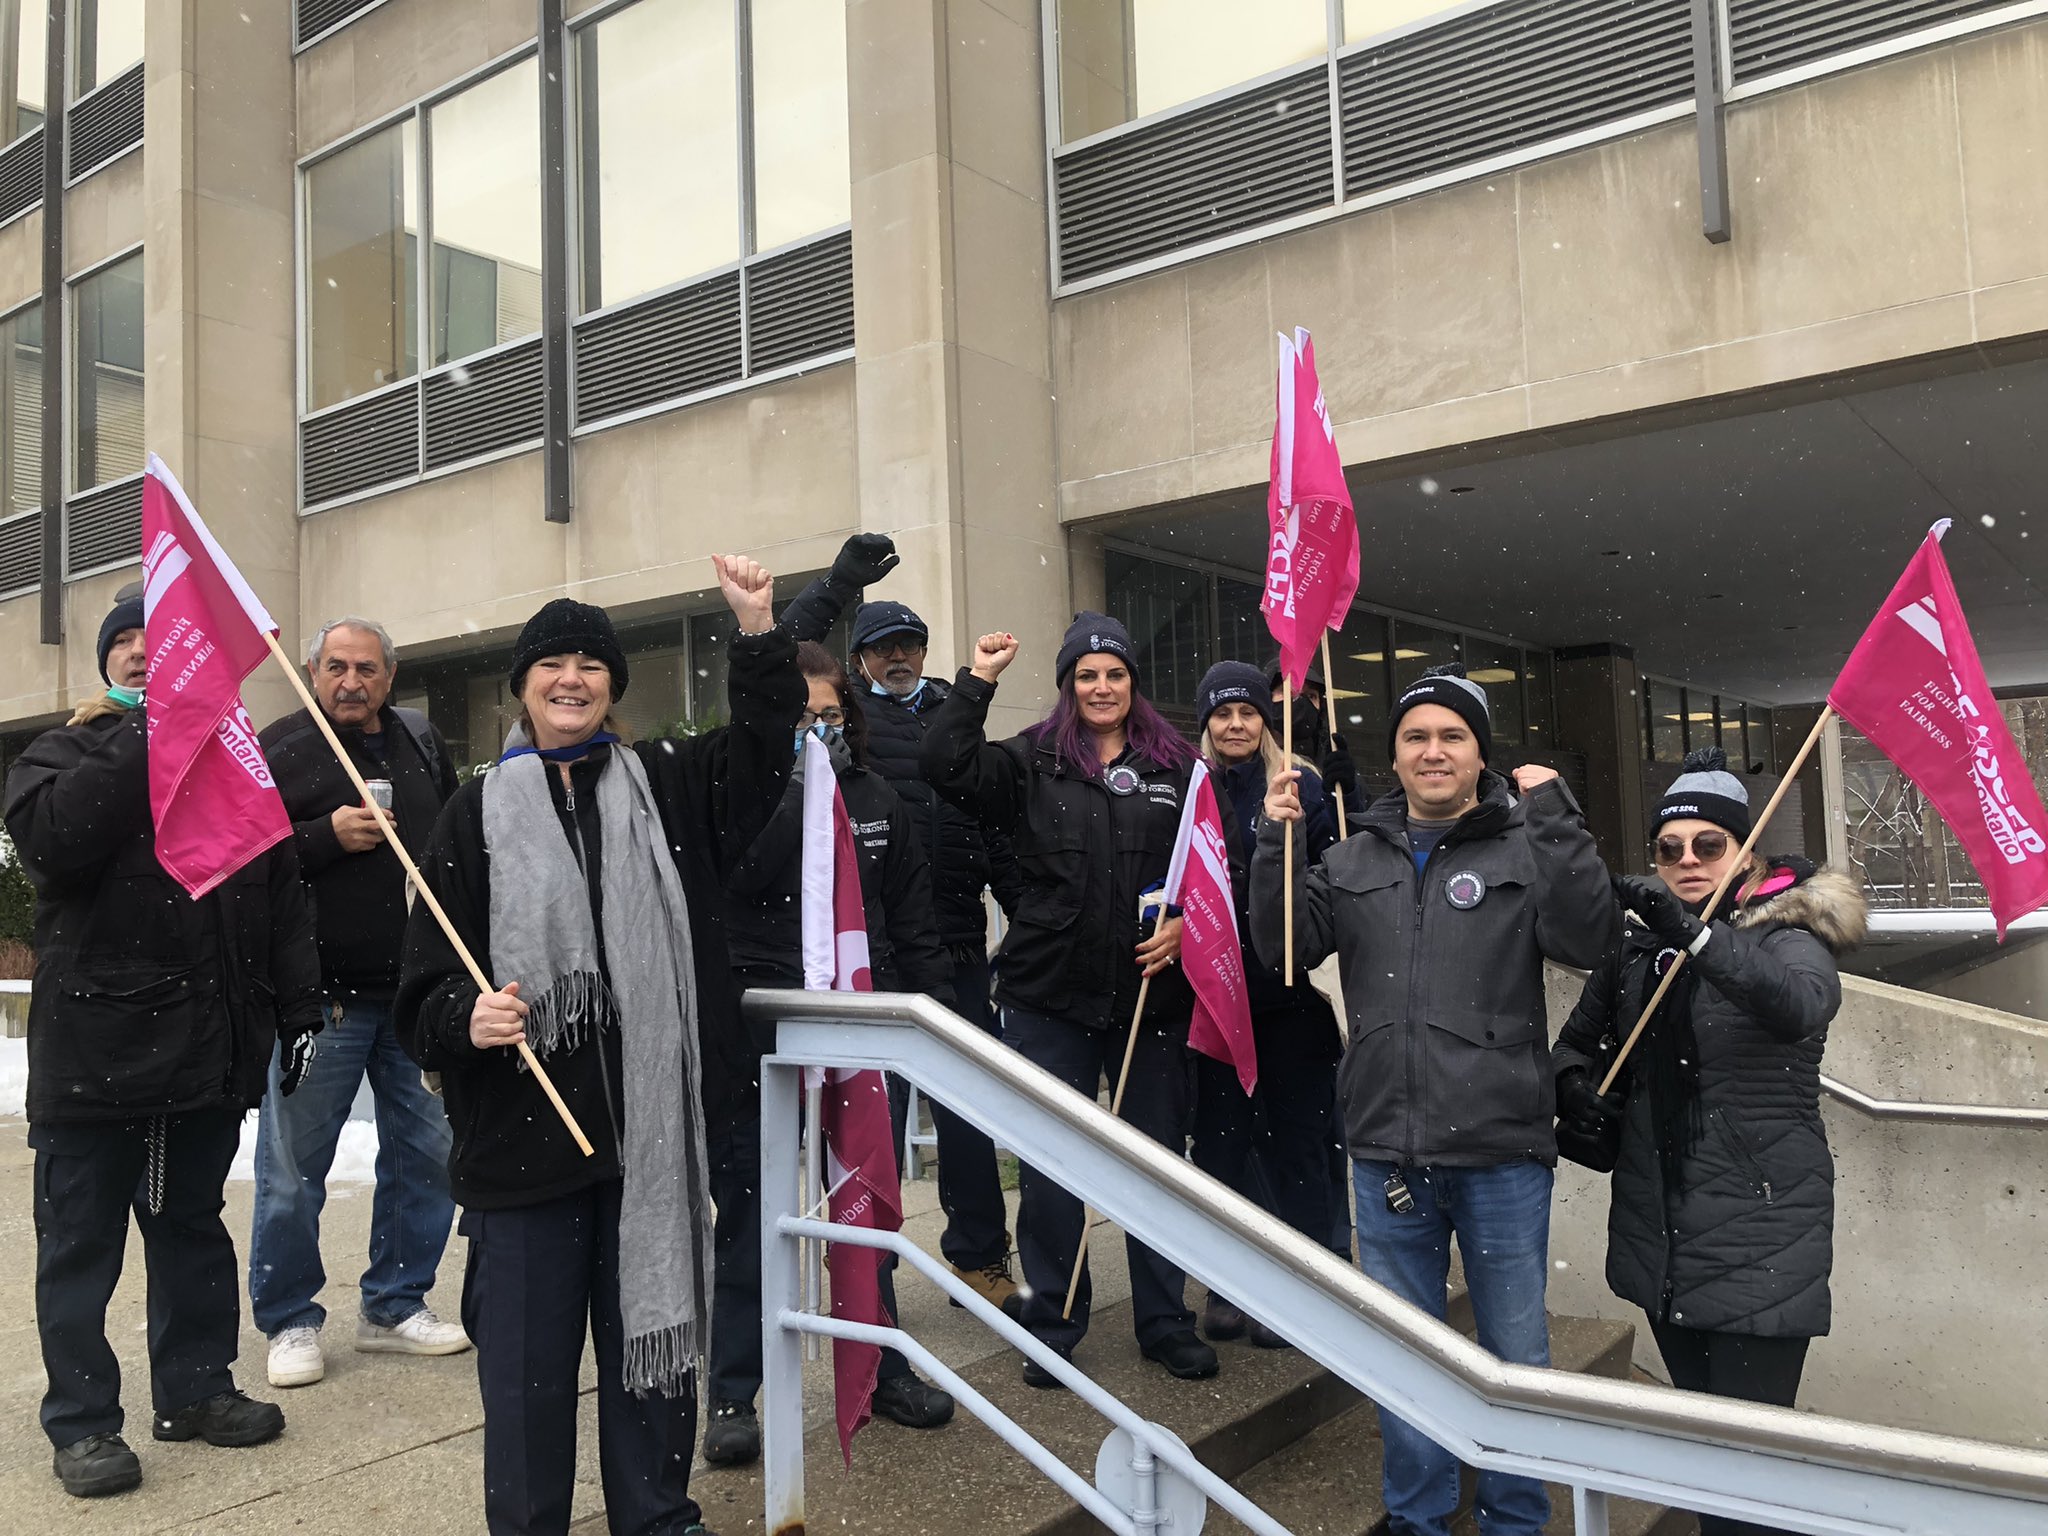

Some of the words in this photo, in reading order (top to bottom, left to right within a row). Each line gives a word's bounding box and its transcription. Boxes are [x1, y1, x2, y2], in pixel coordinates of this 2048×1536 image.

[1216, 690, 1250, 700] TORONTO
[1911, 691, 1936, 712] FOR
[1899, 699, 1953, 750] FAIRNESS
[1975, 754, 2046, 854] SCFP
[858, 824, 890, 834] TORONTO
[1449, 874, 1462, 887] JOB
[1462, 873, 1481, 902] SECURITY
[1184, 895, 1197, 913] FOR
[1191, 887, 1223, 932] FIGHTING
